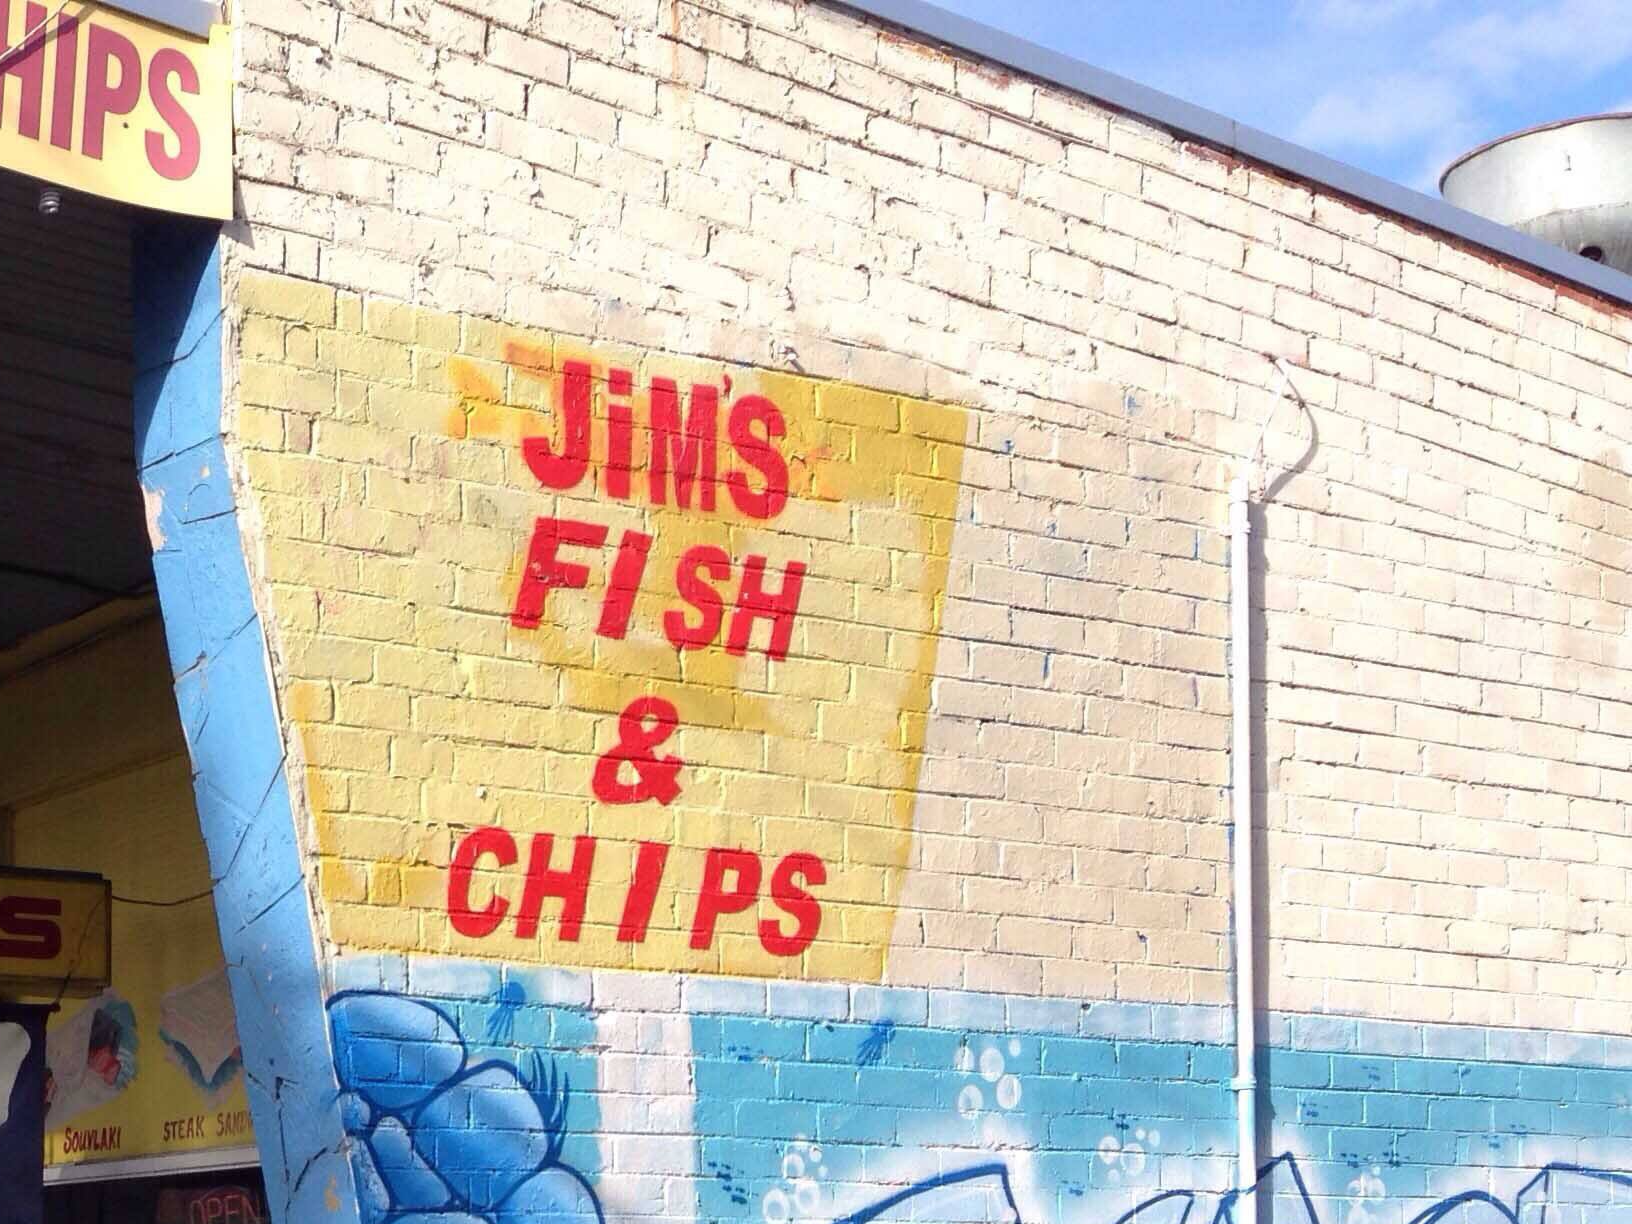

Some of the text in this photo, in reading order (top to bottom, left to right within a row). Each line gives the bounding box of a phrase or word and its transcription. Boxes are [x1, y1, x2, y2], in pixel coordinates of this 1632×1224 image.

[509, 516, 808, 662] FISH
[590, 695, 684, 807] &
[445, 825, 828, 957] CHIPS
[63, 1126, 121, 1154] SOUVLAKI
[163, 1115, 206, 1143] STEAK
